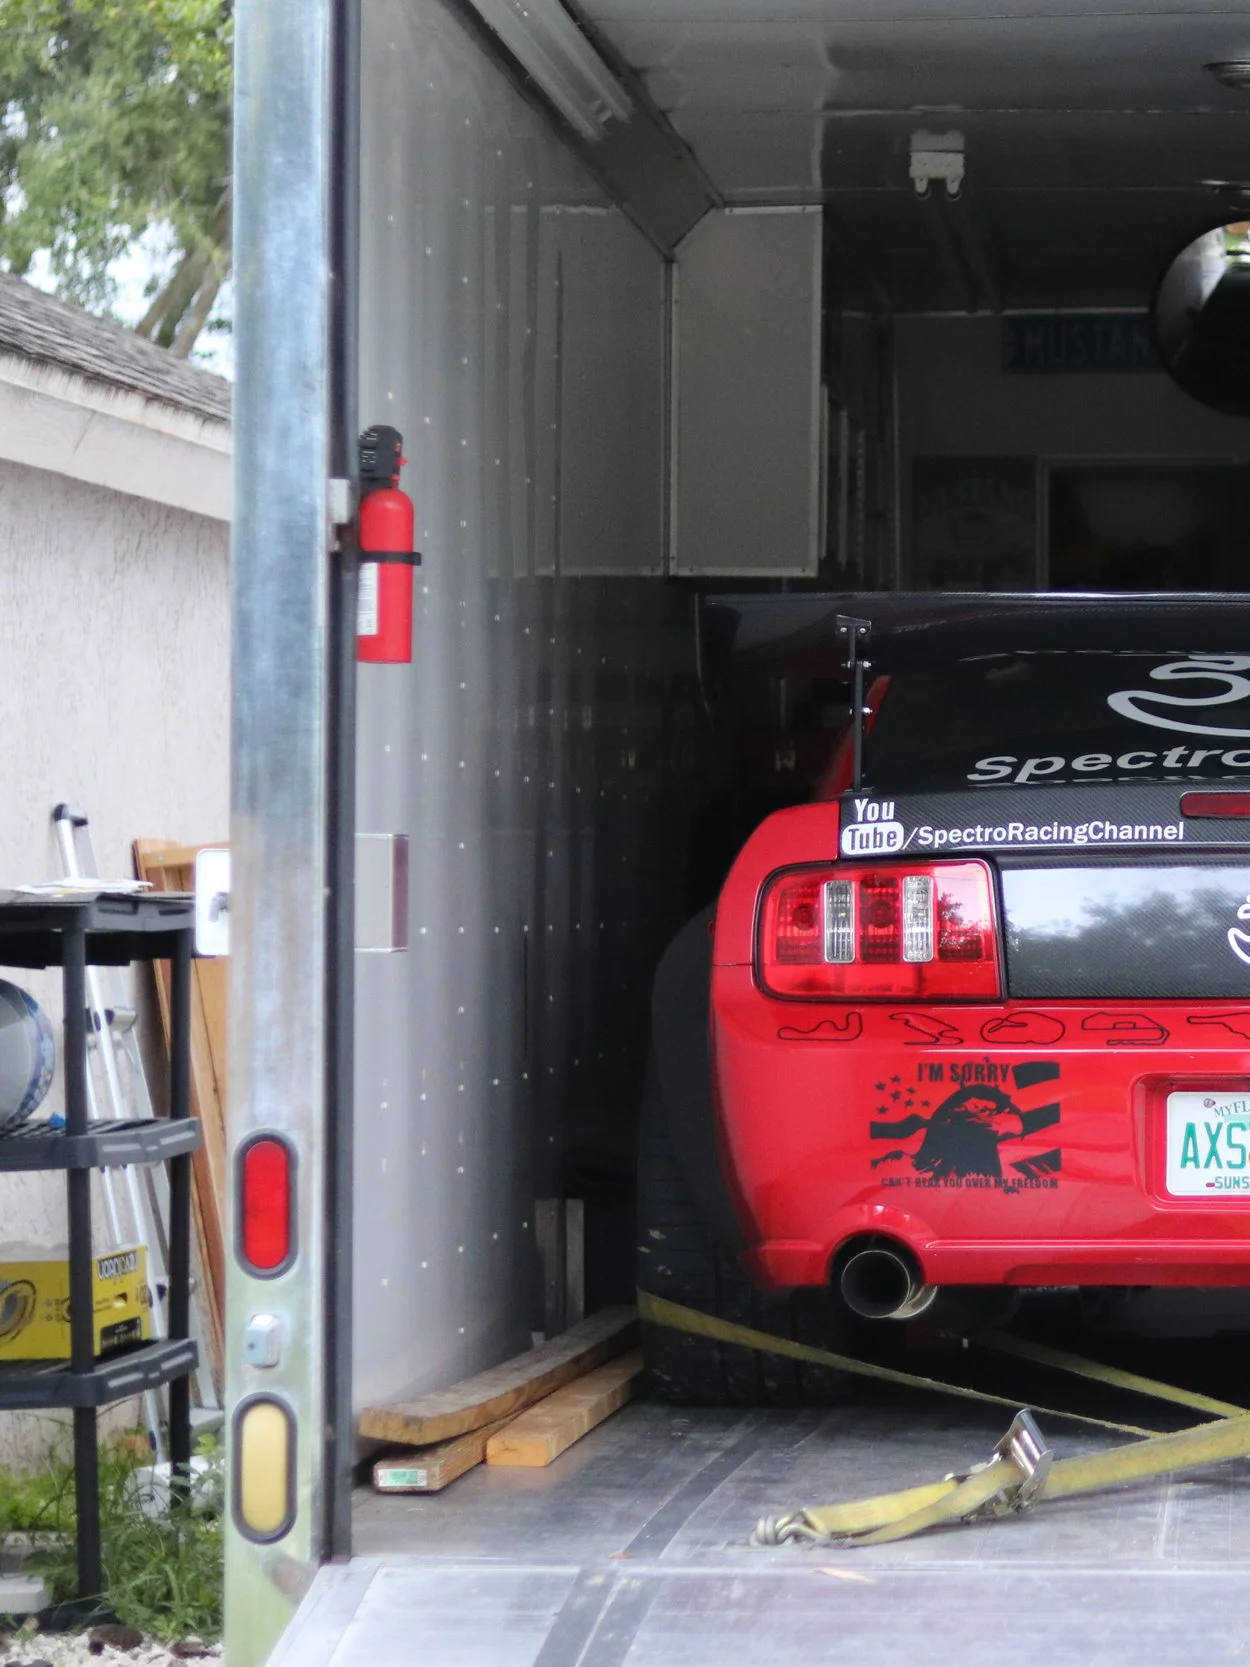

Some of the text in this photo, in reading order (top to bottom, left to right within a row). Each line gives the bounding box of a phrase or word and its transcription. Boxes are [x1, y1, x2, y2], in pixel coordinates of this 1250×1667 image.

[1022, 323, 1150, 365] MUSTAN
[853, 799, 897, 823] You
[846, 825, 899, 851] Tube
[917, 1062, 1010, 1083] I'M SORRY
[943, 1177, 962, 1188] YOU
[994, 1177, 1008, 1190] MY
[1012, 1177, 1058, 1189] FREEDOM
